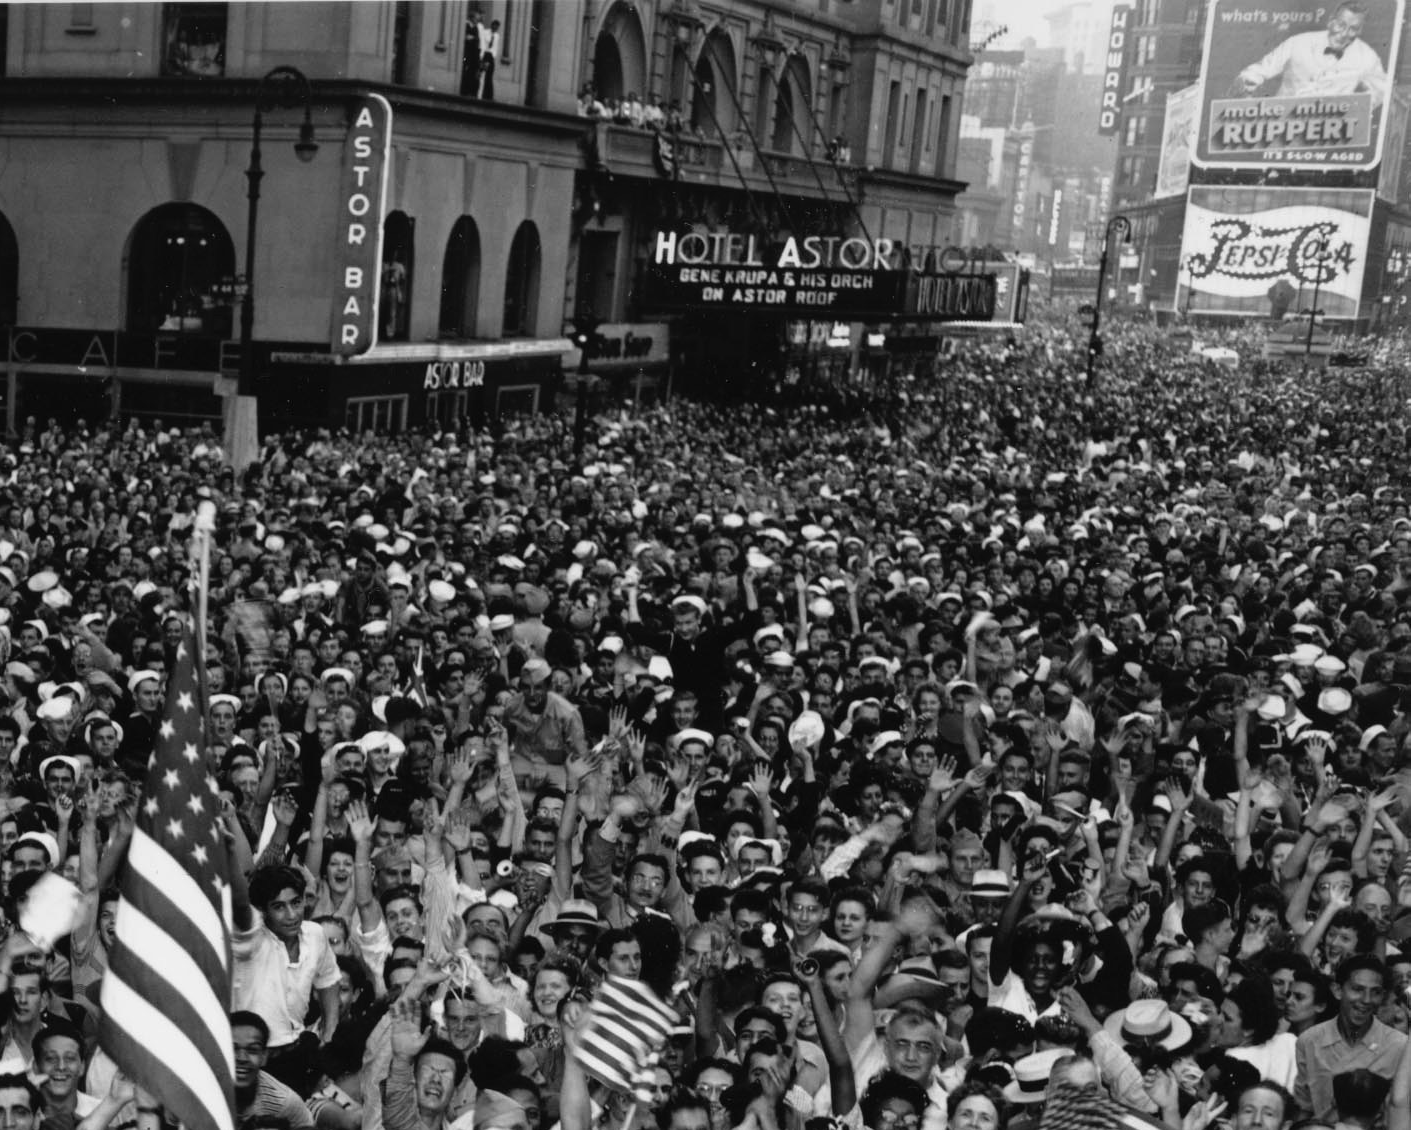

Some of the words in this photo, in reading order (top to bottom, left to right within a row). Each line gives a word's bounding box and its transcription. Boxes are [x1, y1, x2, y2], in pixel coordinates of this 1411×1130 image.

[1272, 8, 1325, 26] yours?
[1101, 12, 1127, 128] HOWARD
[1224, 101, 1285, 118] make
[1295, 99, 1350, 115] mine
[1222, 117, 1358, 144] RUPPERT
[348, 107, 374, 245] ASTOR
[655, 231, 763, 267] HOTEL
[777, 236, 893, 270] ASTOR
[679, 268, 720, 284] GENE
[725, 270, 778, 285] KRUPA
[783, 272, 795, 287] &
[800, 273, 826, 288] HIS
[831, 273, 873, 289] ORCH
[342, 267, 363, 345] BAR
[702, 286, 723, 301] ON
[732, 288, 786, 304] ASTOR
[796, 290, 838, 305] ROOF
[423, 361, 459, 389] ASTOR
[463, 360, 485, 388] BAR
